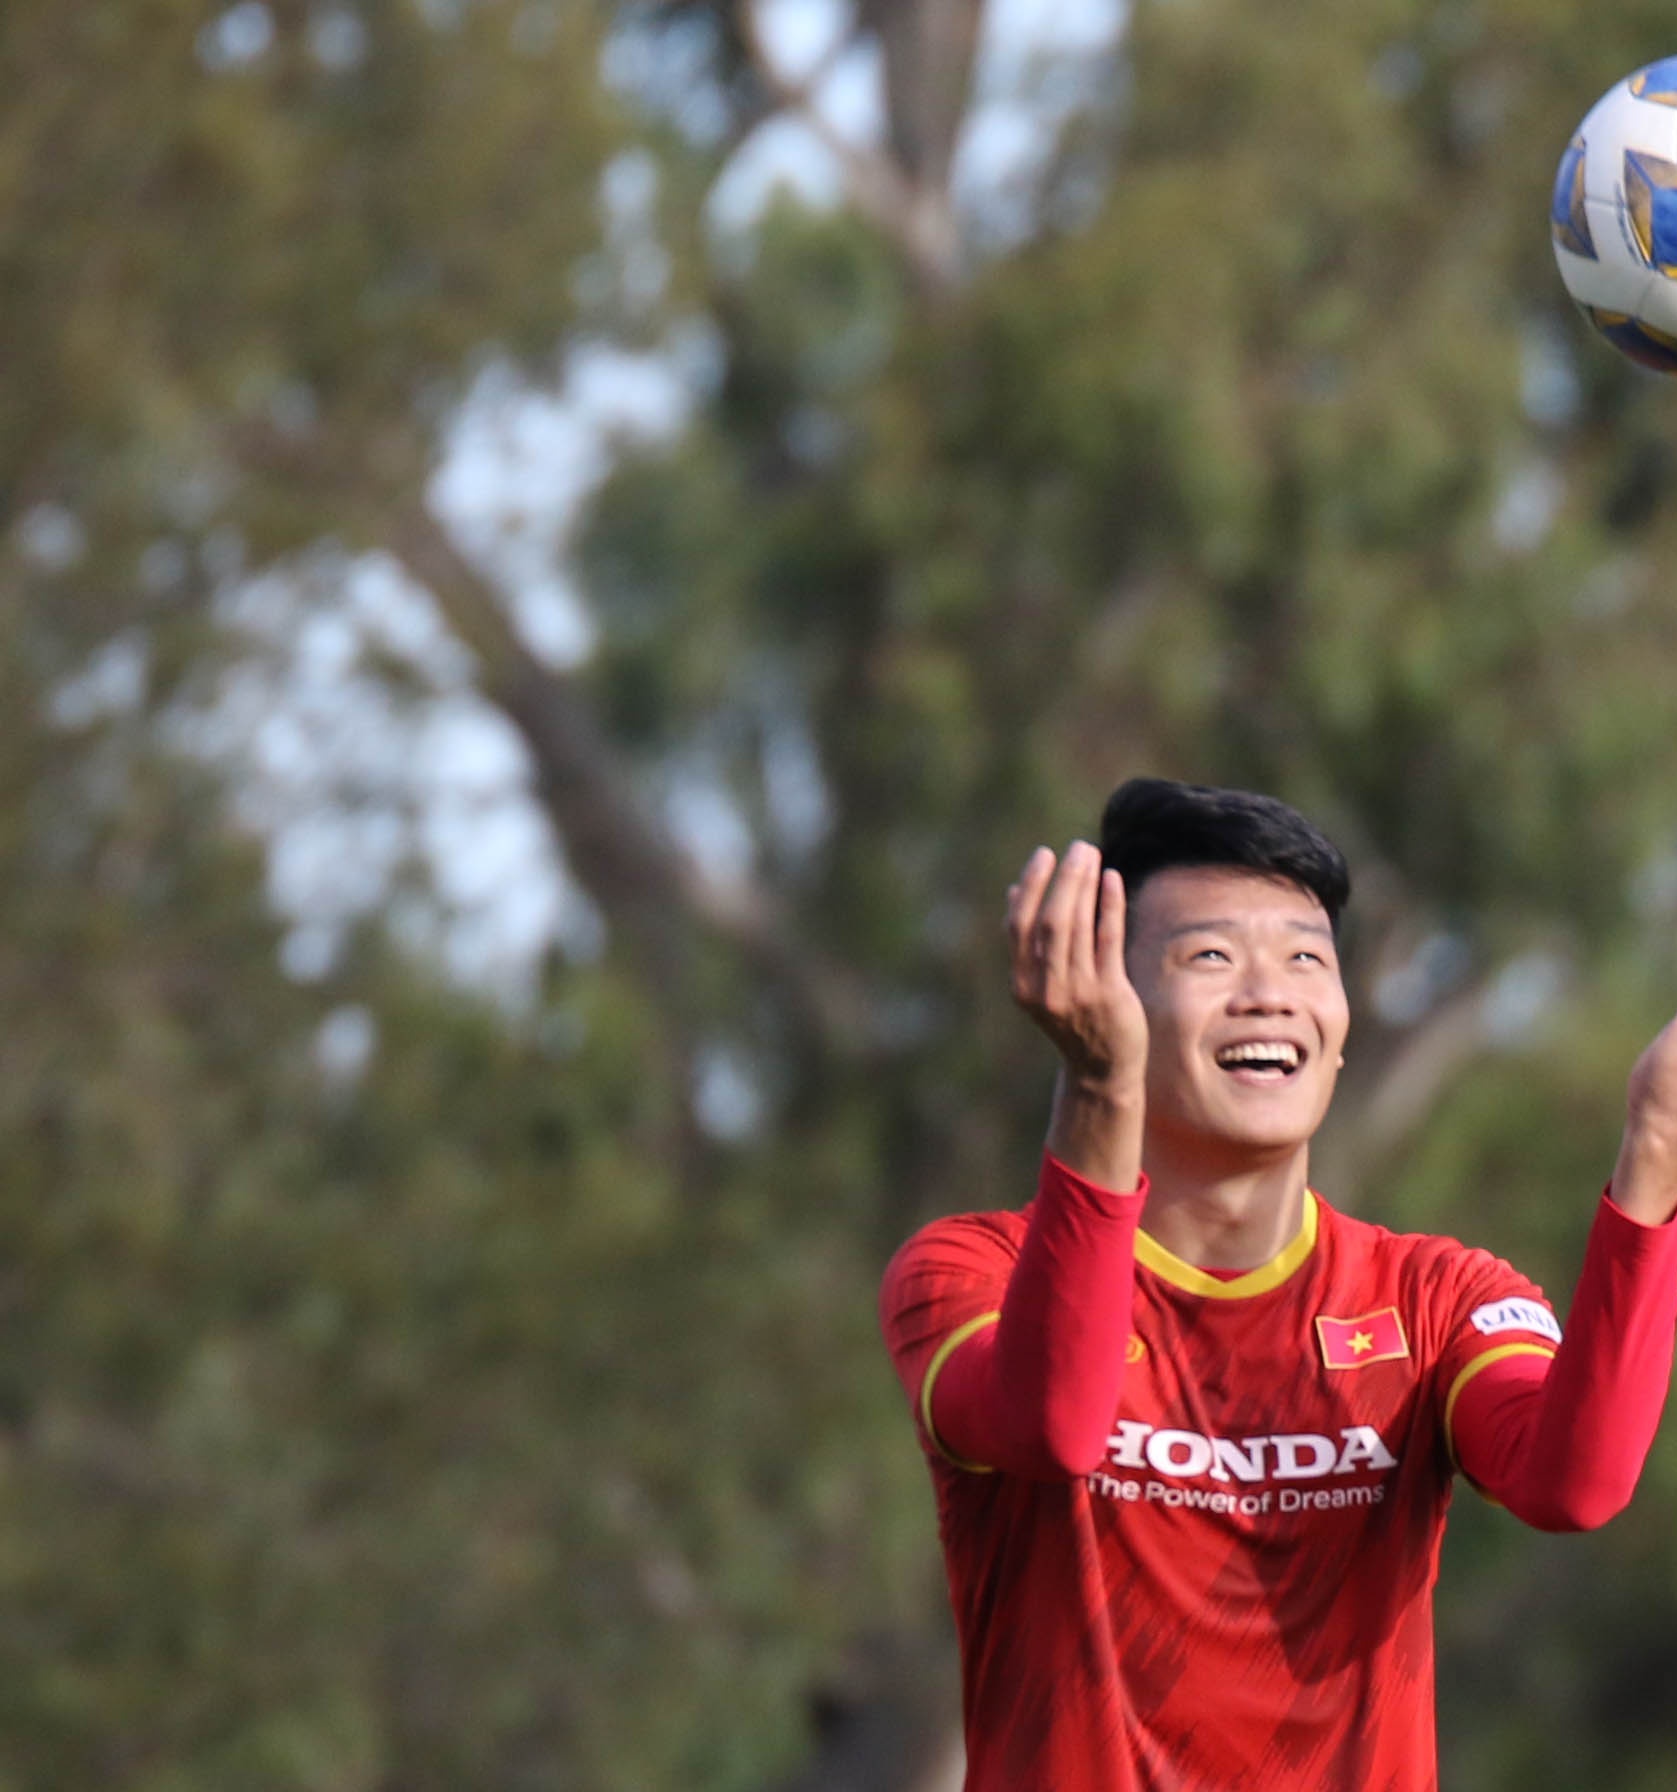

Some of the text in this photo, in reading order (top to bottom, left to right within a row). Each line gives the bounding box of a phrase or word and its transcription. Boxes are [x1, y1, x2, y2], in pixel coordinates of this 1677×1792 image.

[1107, 1419, 1398, 1482] HONDA
[1088, 1472, 1384, 1516] The Power of Dreams
